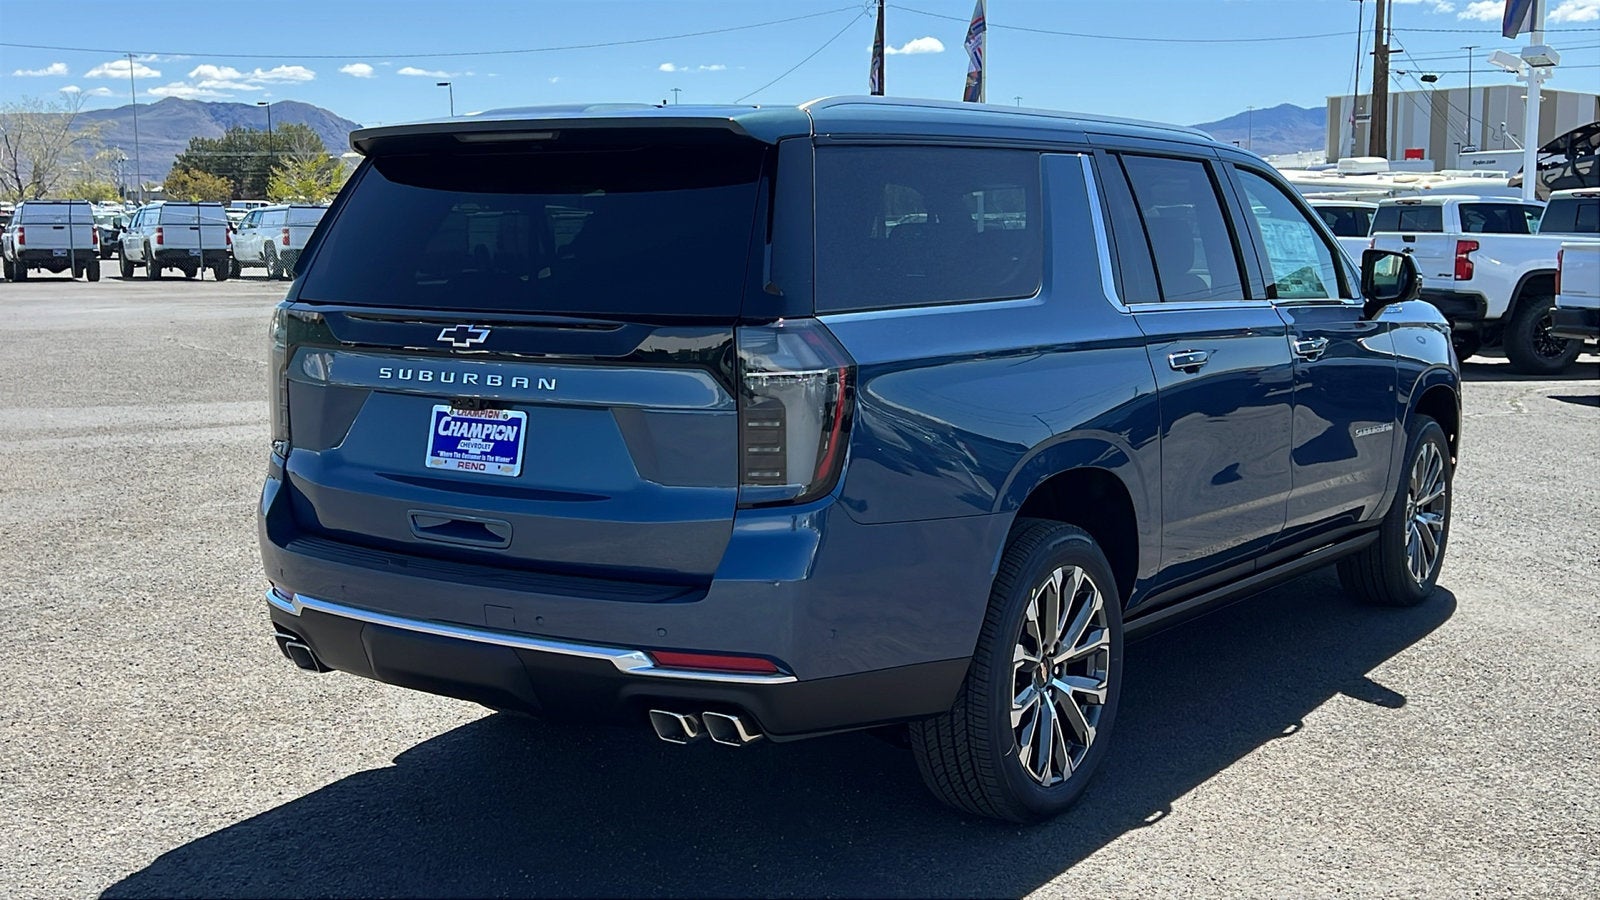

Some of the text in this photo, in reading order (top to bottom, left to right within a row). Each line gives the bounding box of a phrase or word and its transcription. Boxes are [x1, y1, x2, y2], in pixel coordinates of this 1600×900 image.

[379, 367, 557, 390] SUBURBAN
[456, 409, 500, 419] CHAMPION
[438, 416, 518, 442] CHAMPION
[460, 441, 492, 450] CHEVROLET
[457, 461, 486, 471] RENO
